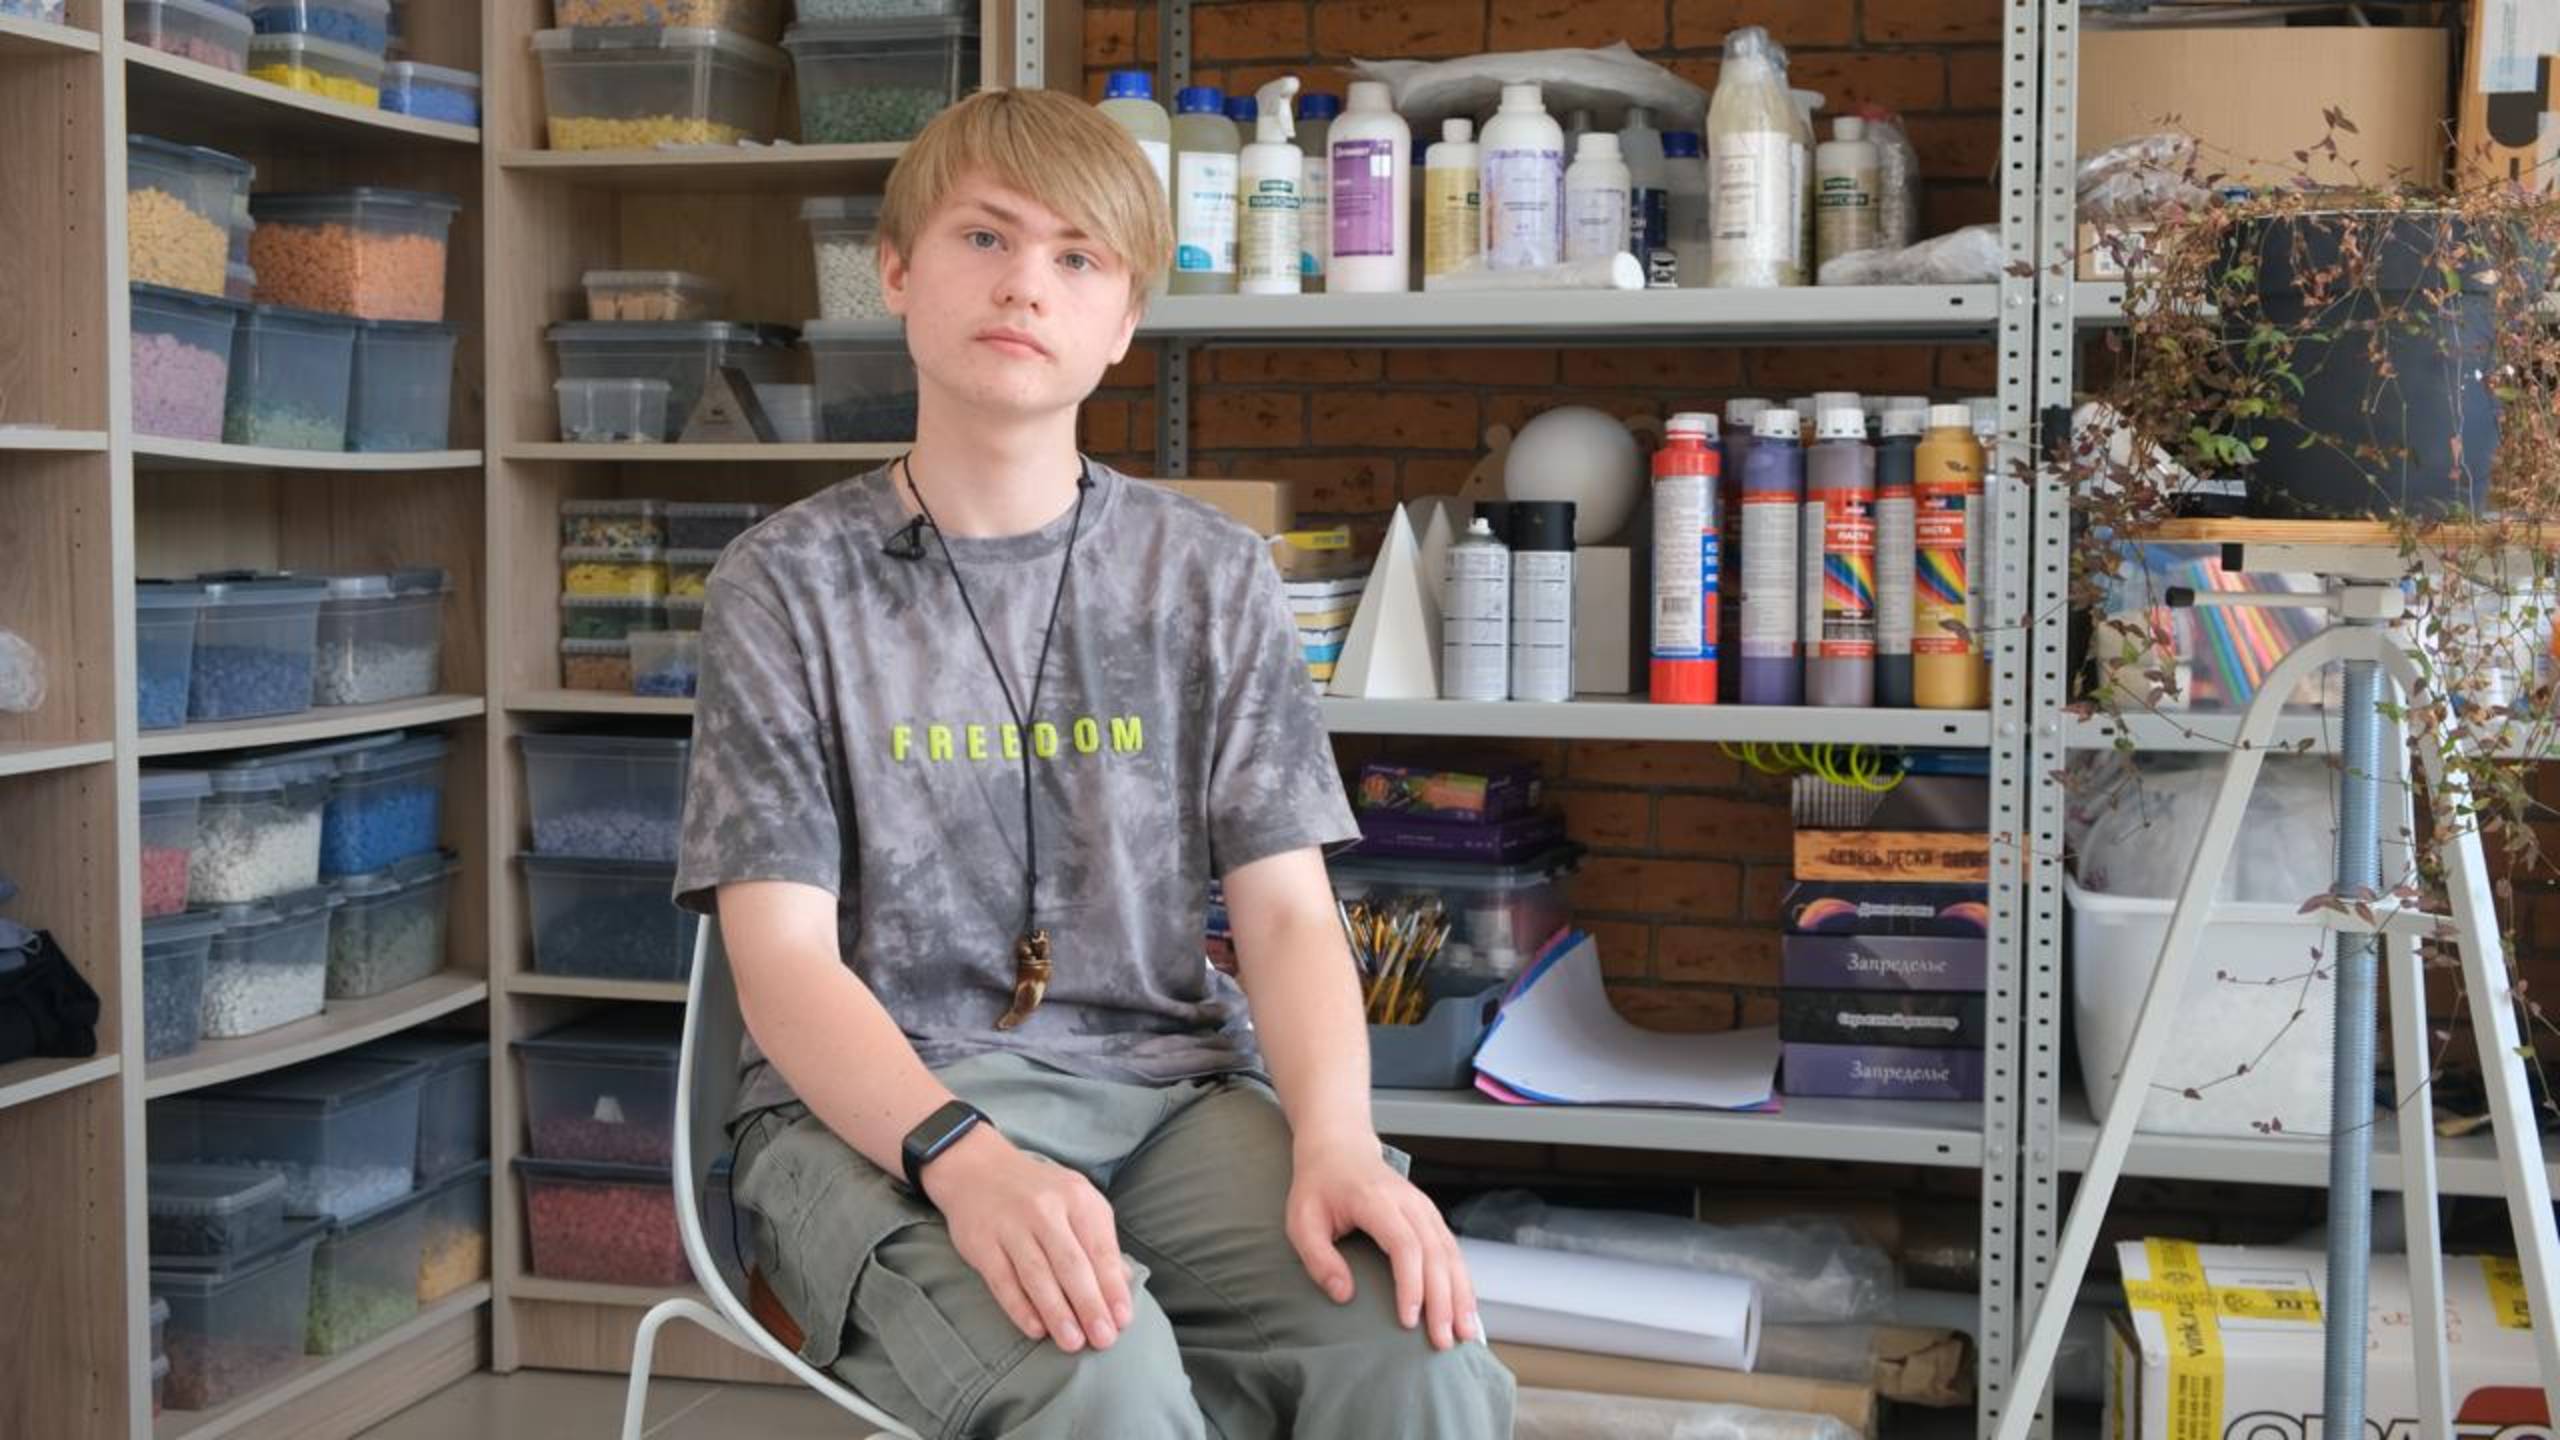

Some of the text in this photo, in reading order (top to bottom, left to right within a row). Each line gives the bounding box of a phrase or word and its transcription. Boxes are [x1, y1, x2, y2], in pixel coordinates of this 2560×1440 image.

[891, 716, 1144, 762] FREEDOM
[1846, 953, 1949, 976] Запределье
[1850, 1060, 1951, 1083] Запределье
